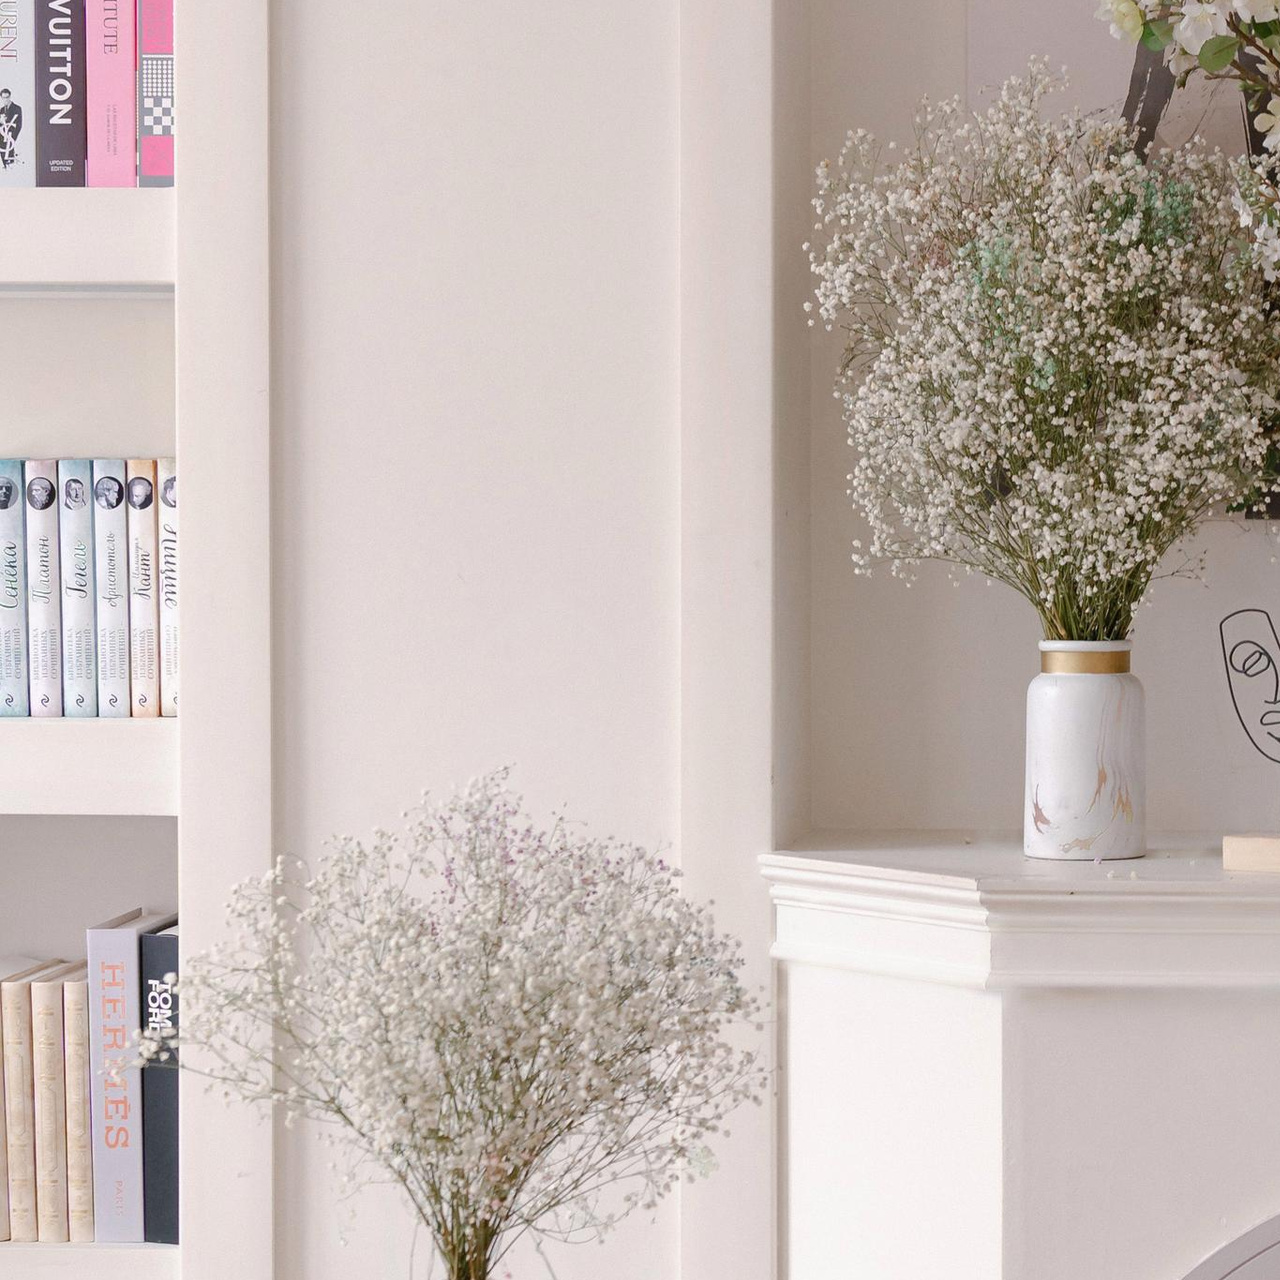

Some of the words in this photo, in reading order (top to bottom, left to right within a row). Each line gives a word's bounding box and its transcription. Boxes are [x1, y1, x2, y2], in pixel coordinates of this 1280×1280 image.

[30, 535, 51, 604] Платон
[65, 540, 88, 599] Гегель
[102, 532, 123, 608] Аристотель
[133, 550, 151, 601] Кант
[159, 981, 172, 1028] TOM
[113, 1180, 124, 1216] PARIS
